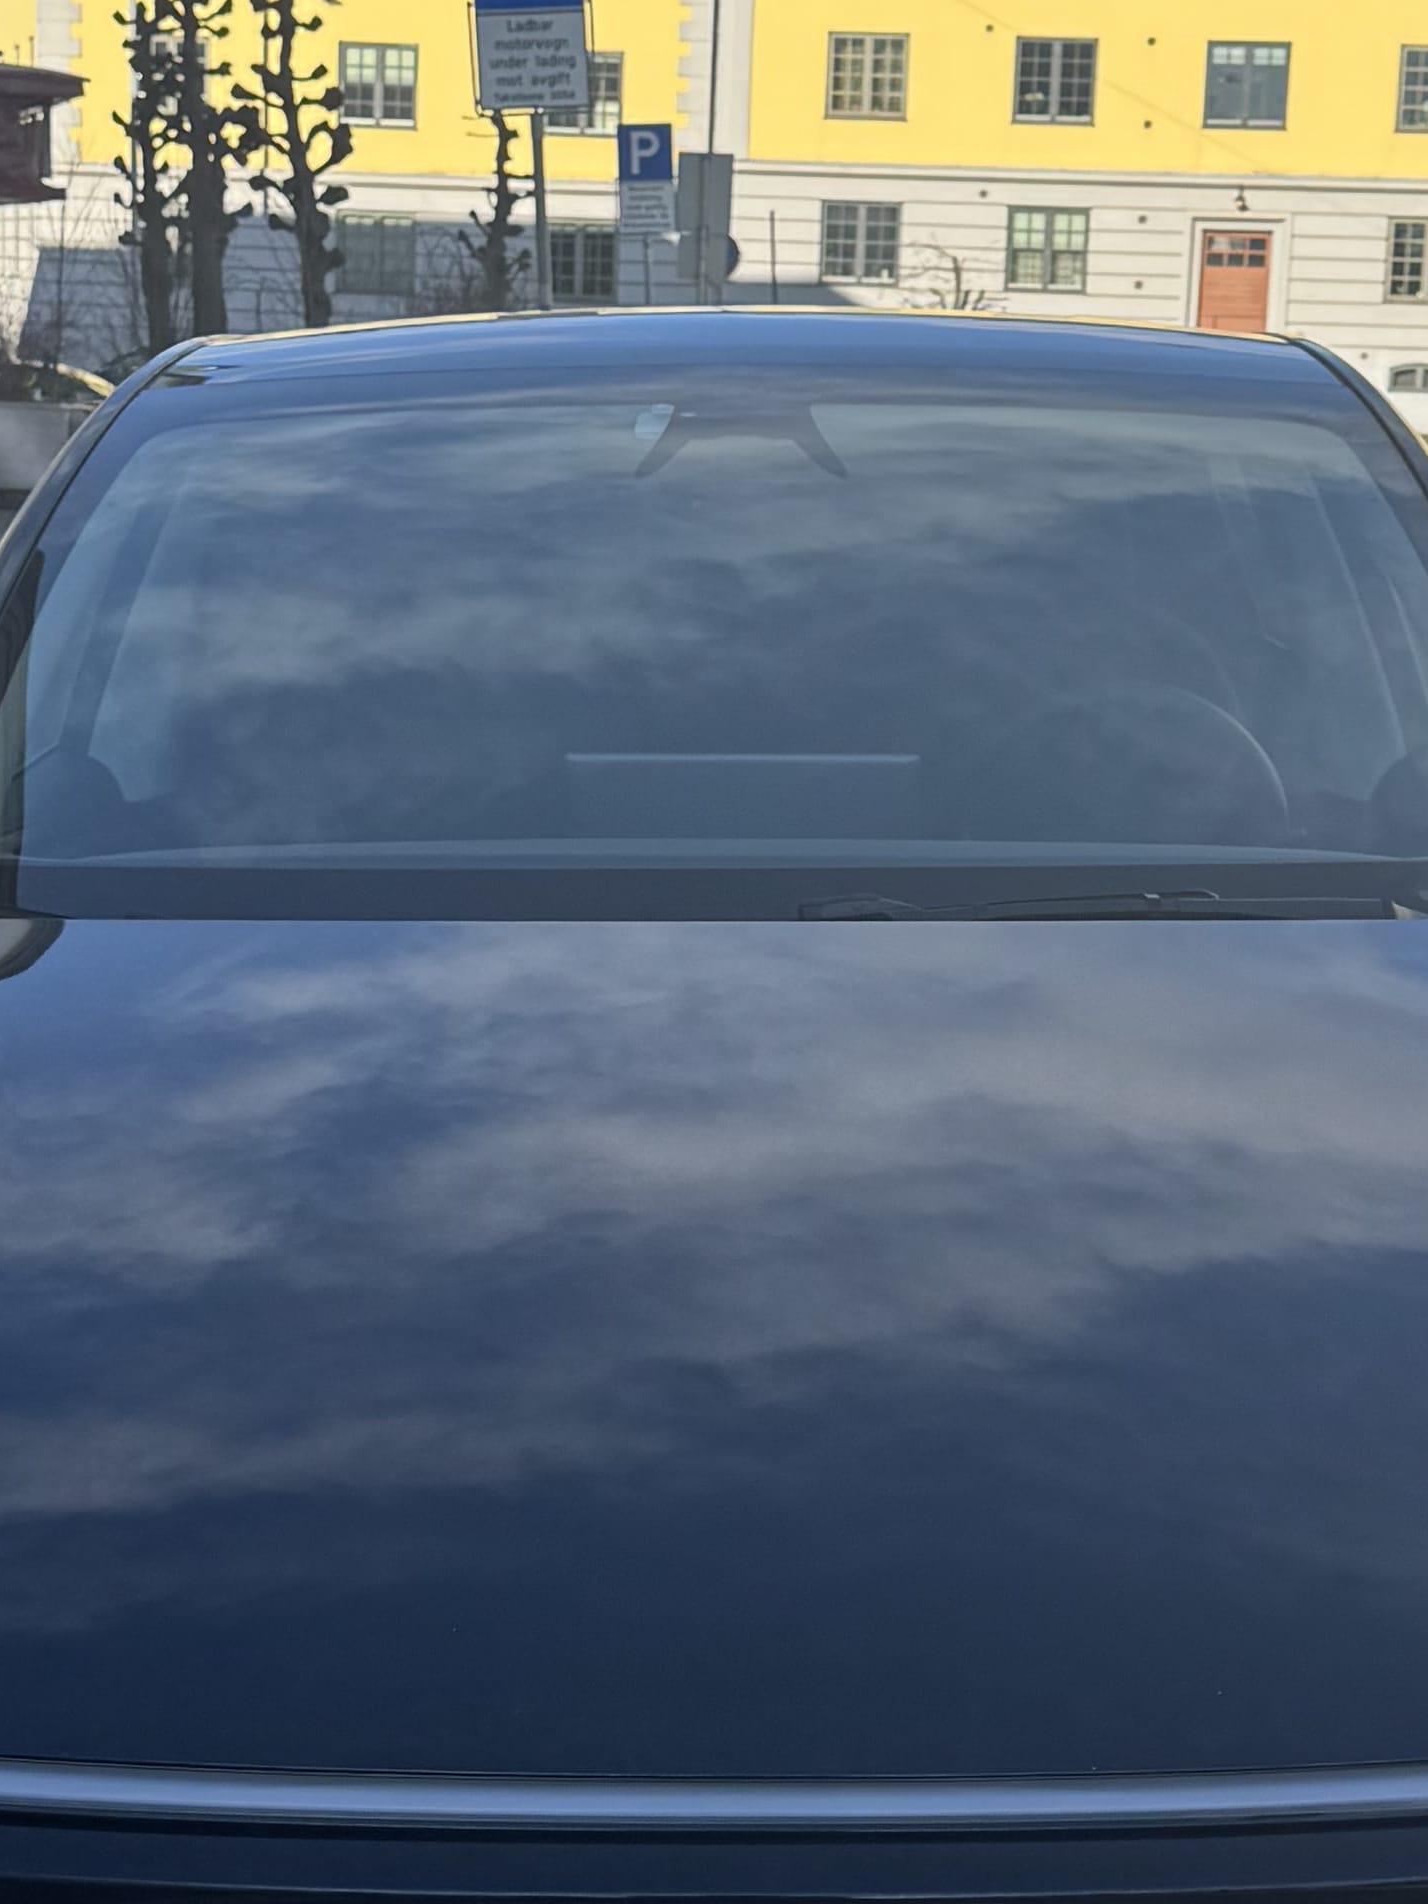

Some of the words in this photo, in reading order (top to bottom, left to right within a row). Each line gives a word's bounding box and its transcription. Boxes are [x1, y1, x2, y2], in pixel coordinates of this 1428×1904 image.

[506, 20, 553, 33] Ladbar
[494, 38, 570, 52] motorvogn
[490, 56, 527, 70] under
[534, 54, 576, 69] lading
[496, 75, 523, 87] mot
[531, 72, 570, 88] avgift
[630, 131, 660, 175] P
